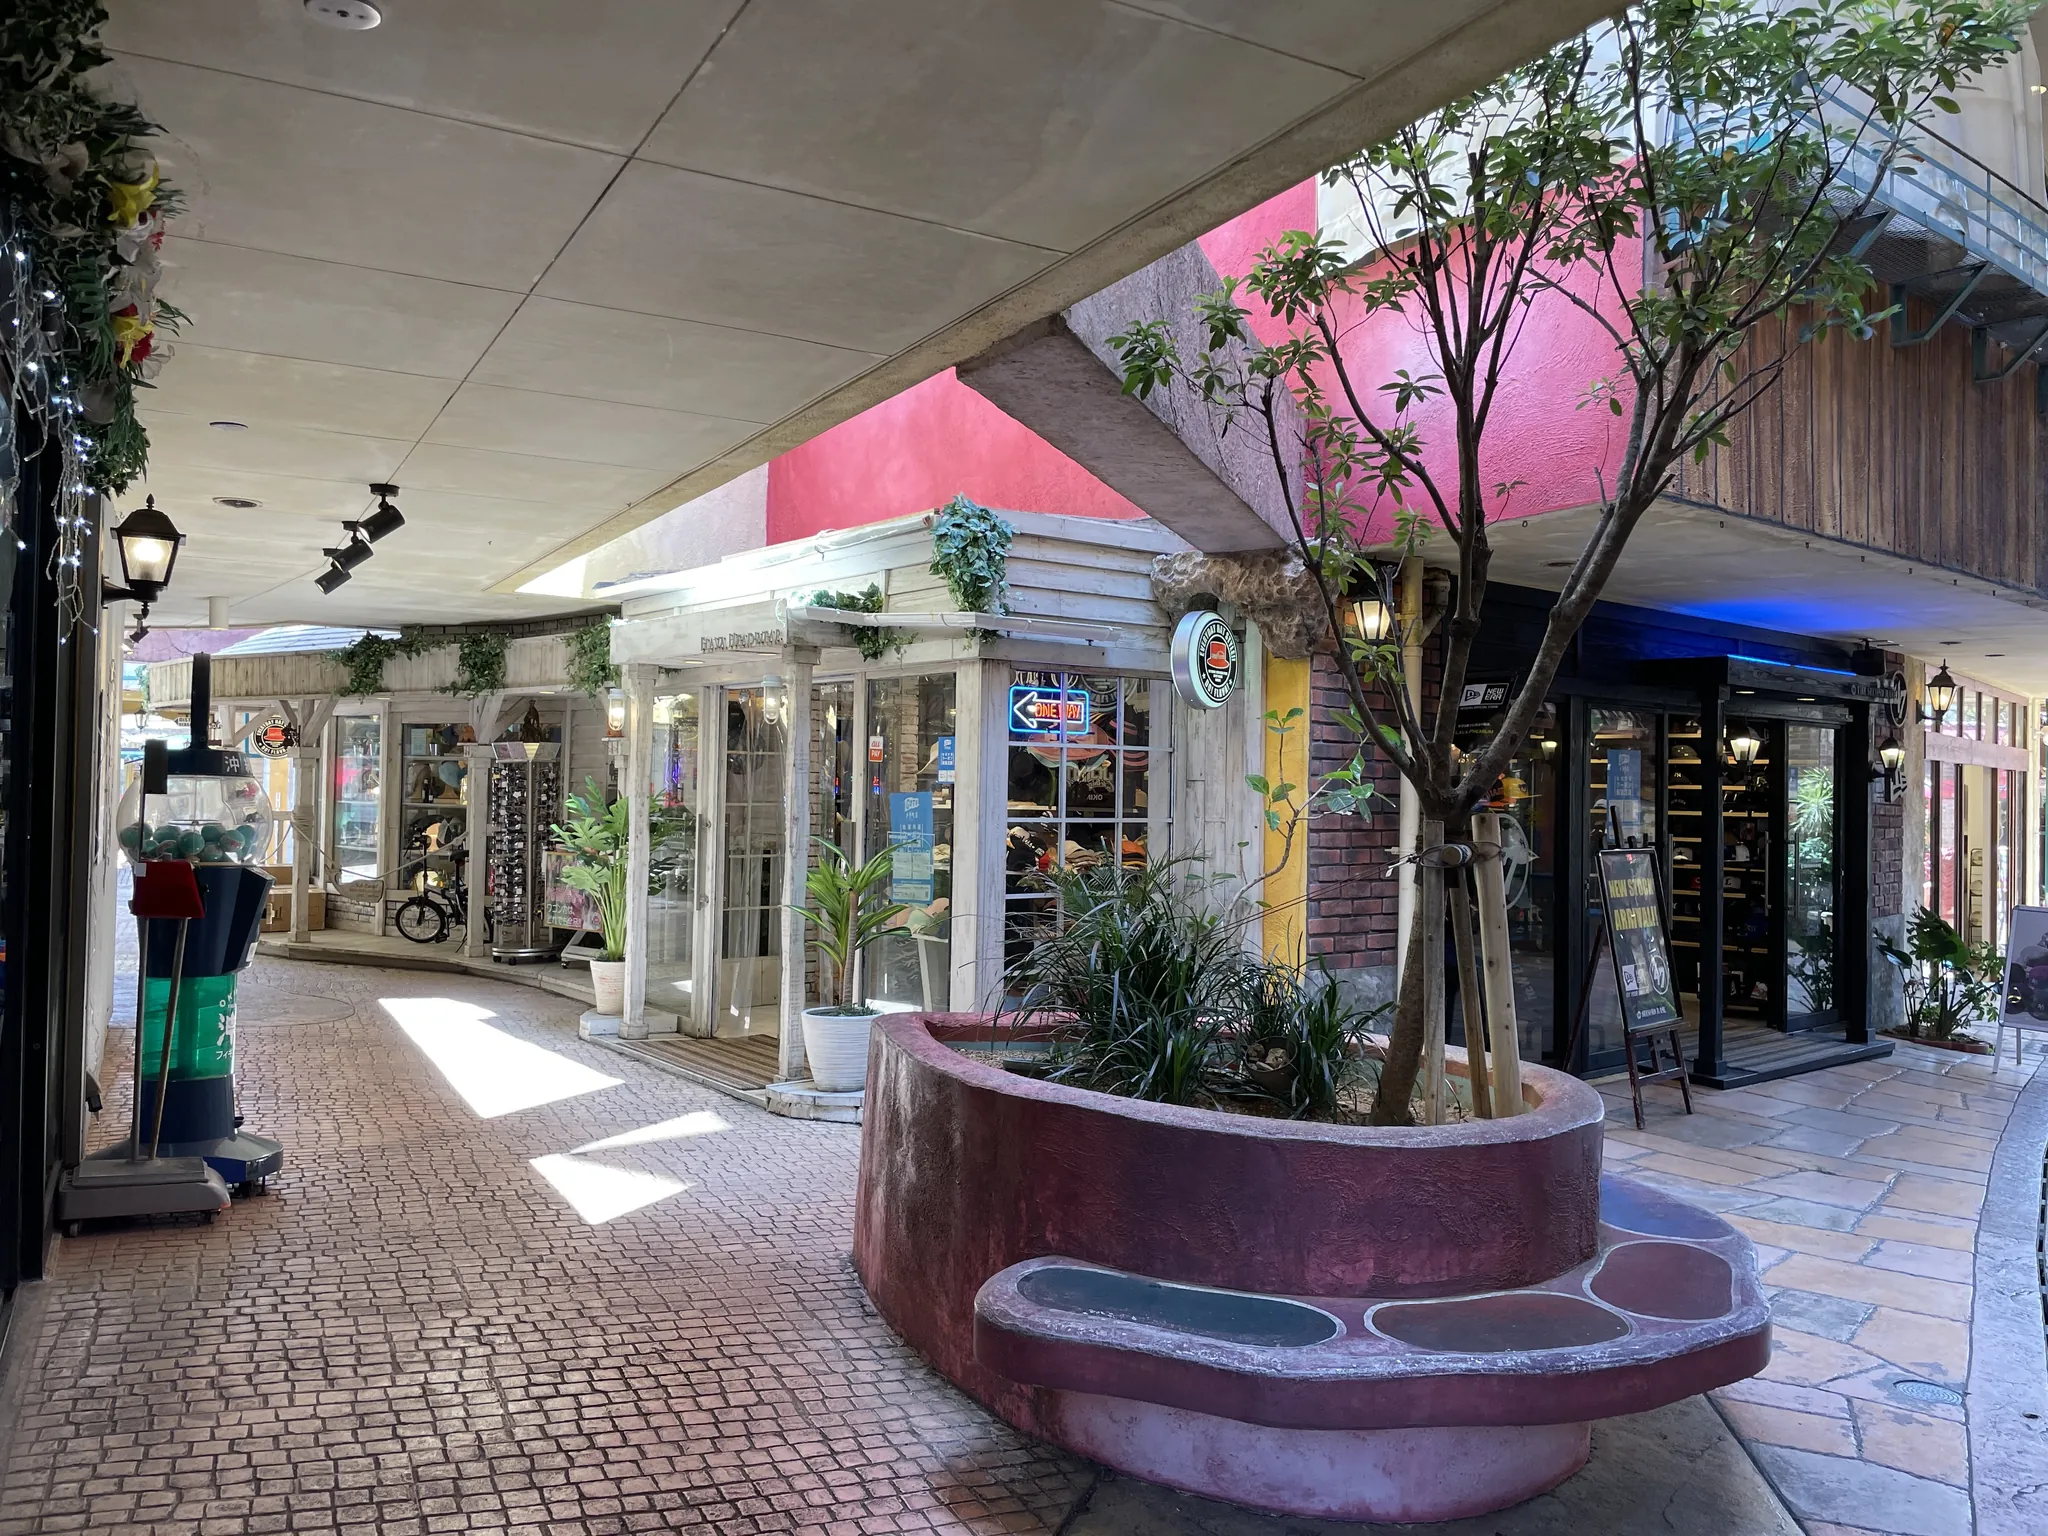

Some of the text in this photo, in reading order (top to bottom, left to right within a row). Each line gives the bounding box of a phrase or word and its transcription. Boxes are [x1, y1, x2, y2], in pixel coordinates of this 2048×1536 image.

[1034, 702, 1059, 718] ONE
[1608, 877, 1655, 898] NEW STOCK
